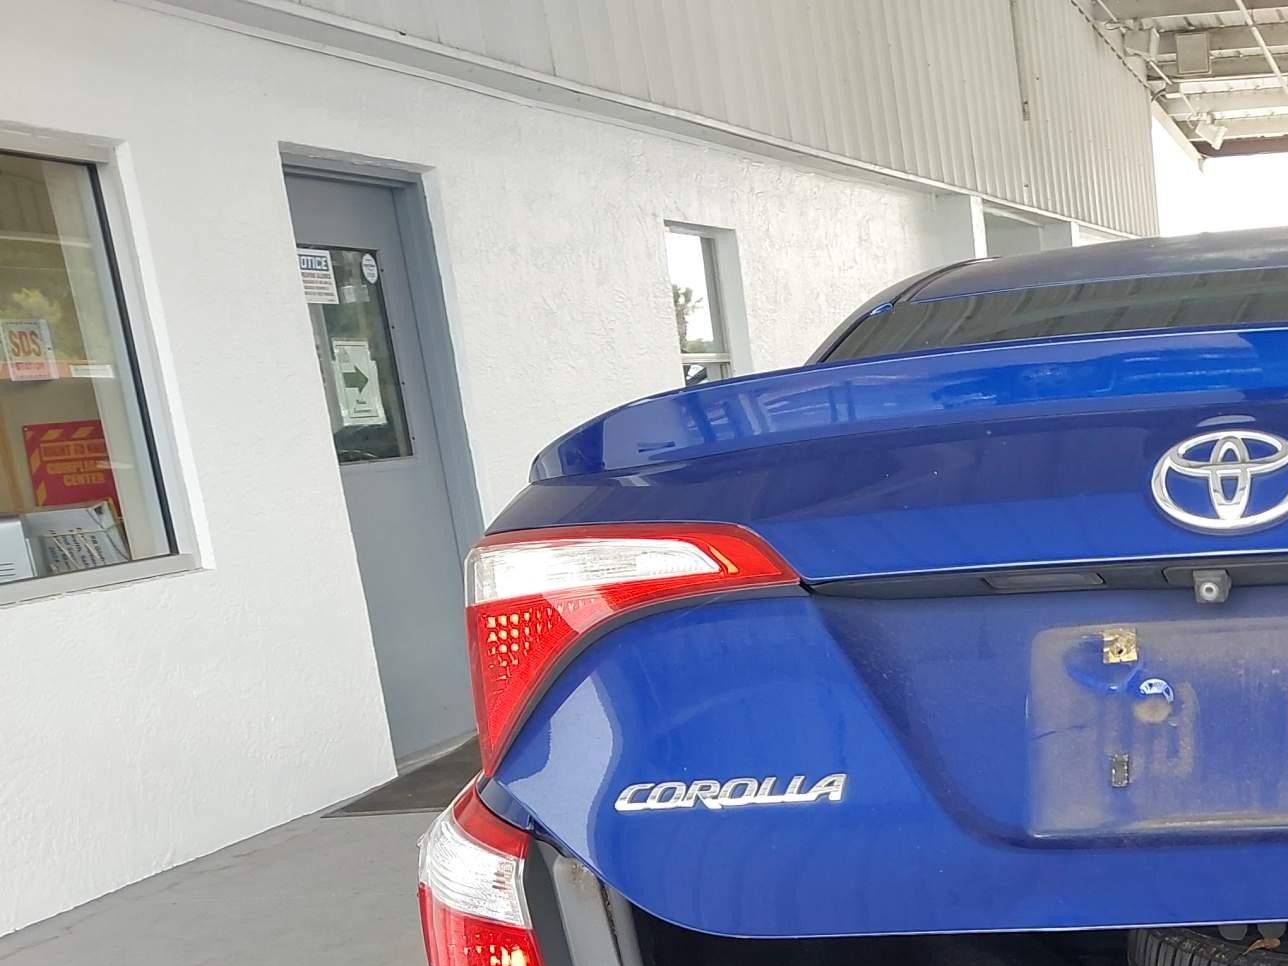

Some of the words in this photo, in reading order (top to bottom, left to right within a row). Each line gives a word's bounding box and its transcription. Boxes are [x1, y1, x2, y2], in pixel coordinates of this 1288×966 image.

[299, 256, 328, 269] OTICE
[8, 330, 42, 357] SDS
[614, 773, 848, 812] COROLLA
